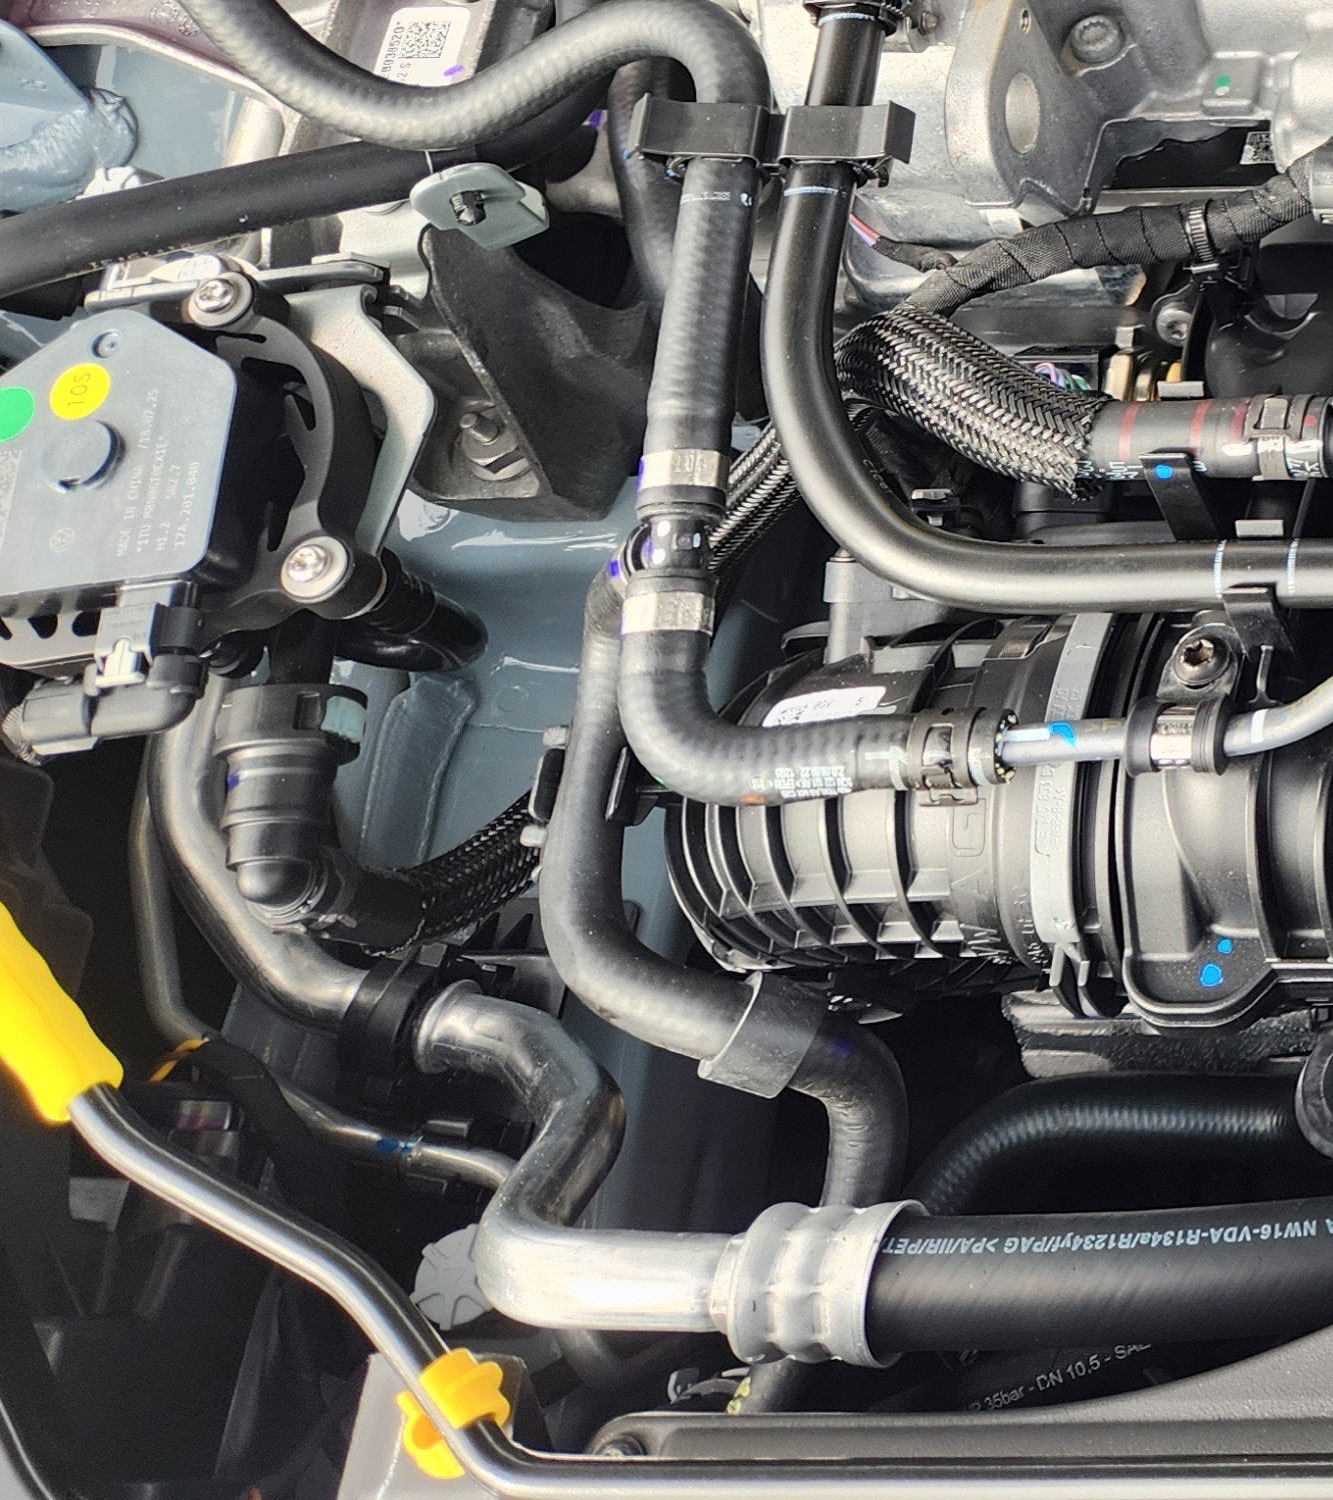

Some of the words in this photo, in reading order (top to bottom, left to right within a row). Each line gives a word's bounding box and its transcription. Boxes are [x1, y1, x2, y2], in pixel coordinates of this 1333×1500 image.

[116, 527, 131, 557] MADE
[1003, 1216, 1317, 1255] NW16-VDA-R134a/R1234yf/PAG
[984, 1386, 1025, 1411] 35bar
[1036, 1369, 1064, 1392] DN
[1066, 1354, 1101, 1381] 10,5
[1114, 1343, 1151, 1360] SA
